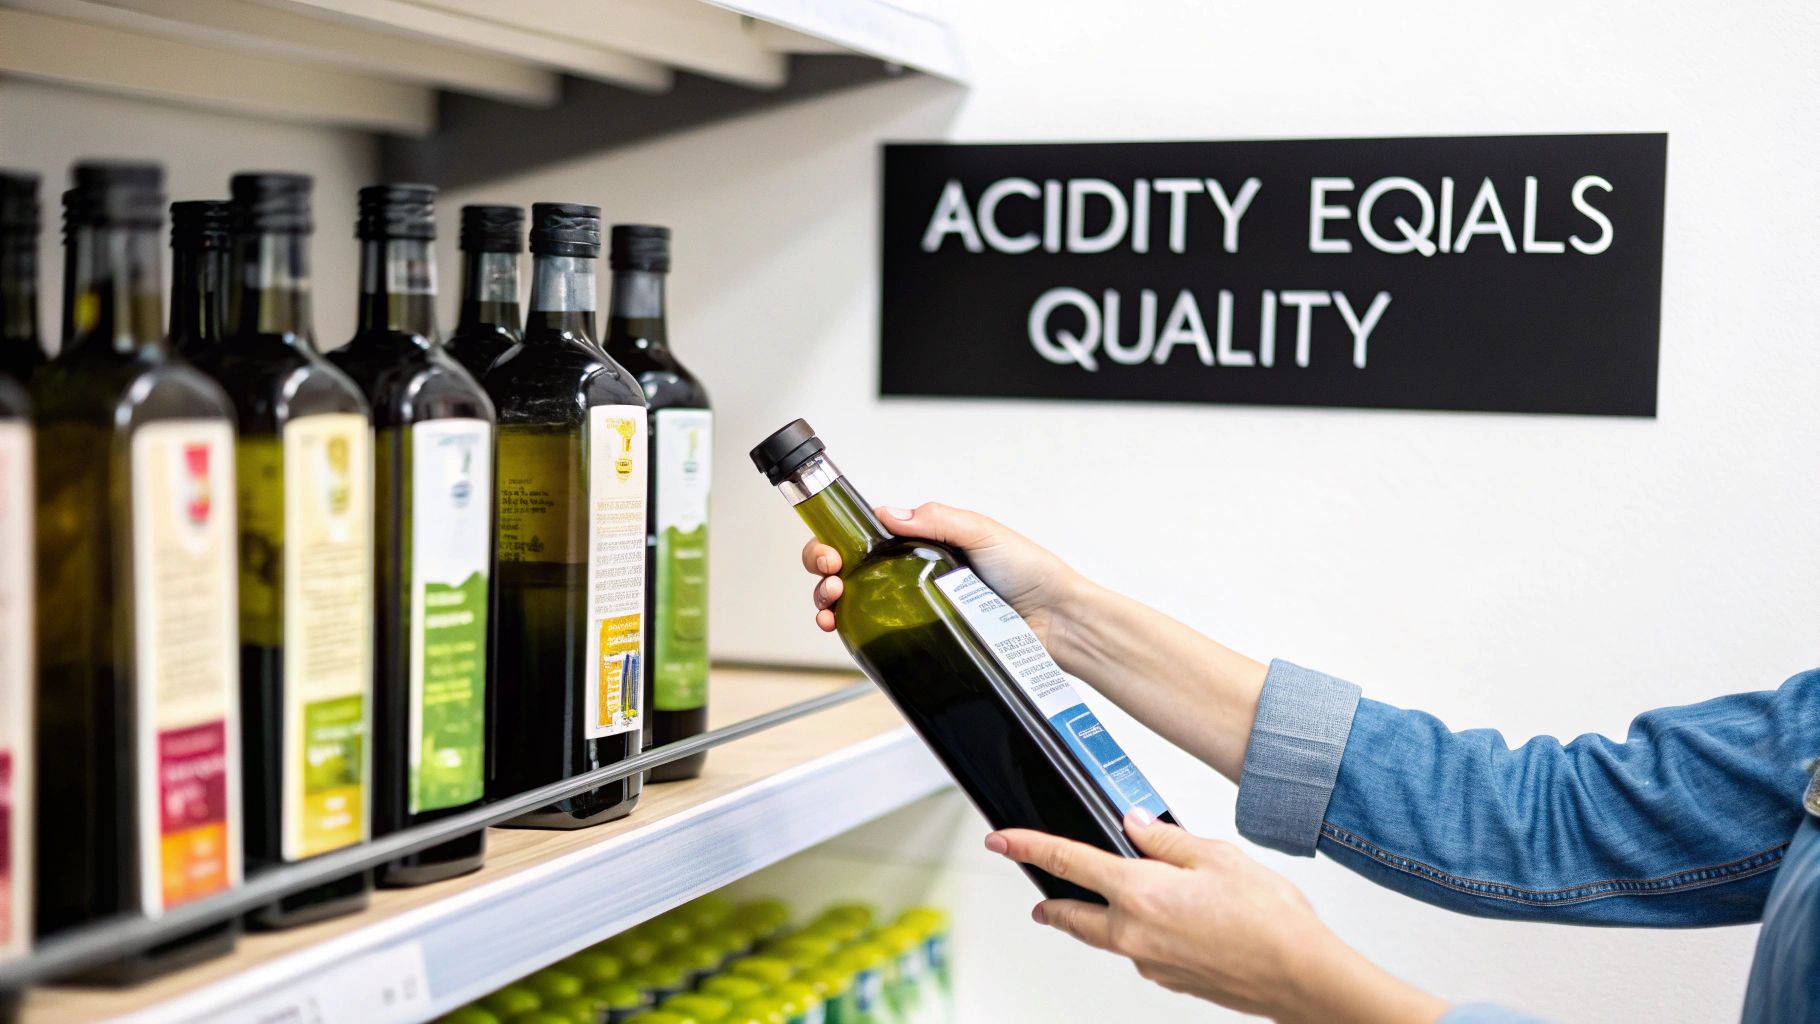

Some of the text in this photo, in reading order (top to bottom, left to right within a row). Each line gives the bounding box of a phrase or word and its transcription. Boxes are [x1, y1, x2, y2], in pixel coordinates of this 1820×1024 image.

[922, 175, 1615, 258] ACIDITY EQIALS
[1028, 287, 1393, 371] QUALITY
